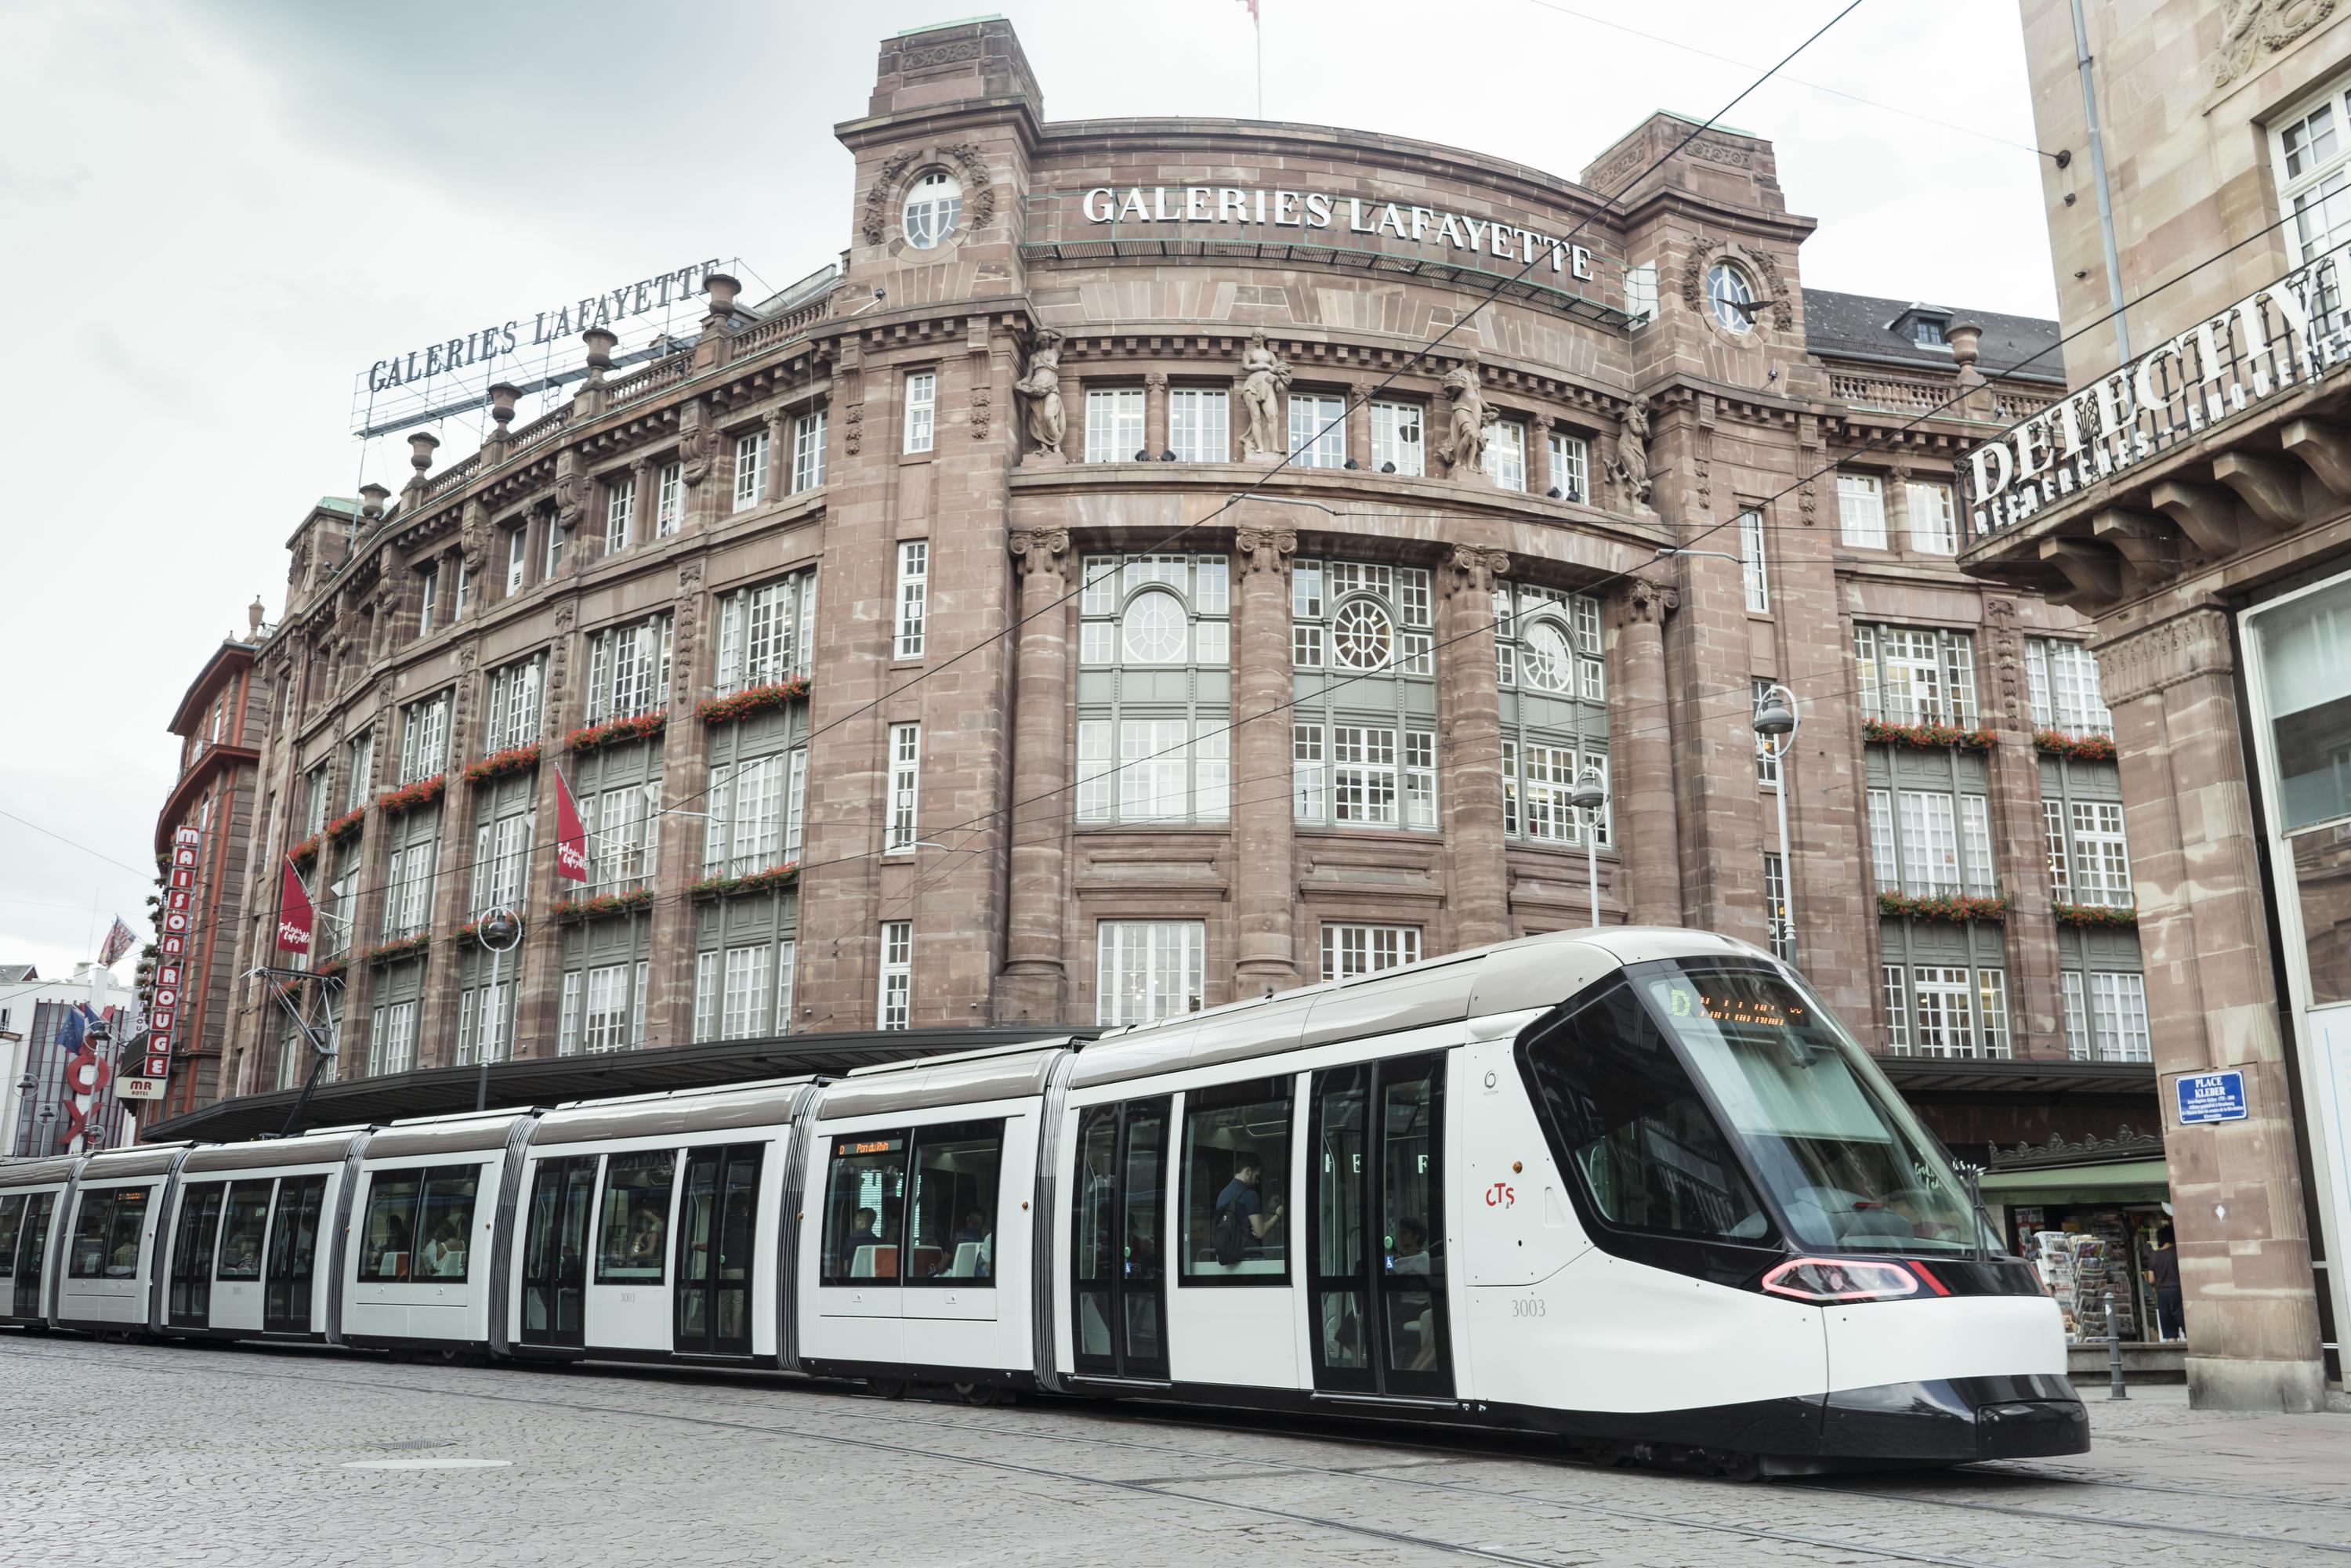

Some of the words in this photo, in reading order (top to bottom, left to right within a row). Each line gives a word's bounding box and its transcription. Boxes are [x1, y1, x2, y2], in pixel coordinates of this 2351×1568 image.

[1083, 186, 1332, 228] GALERIES
[1349, 196, 1596, 281] LAFAYETTE
[368, 320, 518, 393] GALERIES
[532, 258, 720, 345] LAFAYETTE
[1973, 429, 2150, 535] RECHERCHES
[166, 828, 199, 952] MAISON
[1671, 989, 1690, 1016] D
[150, 969, 177, 1074] ROUGE
[129, 1080, 152, 1091] MR
[2194, 1086, 2226, 1099] KLEBER
[2195, 1076, 2223, 1088] PLACE
[839, 1145, 845, 1155] D
[1485, 1182, 1516, 1209] CTS
[1511, 1298, 1546, 1317] 3003
